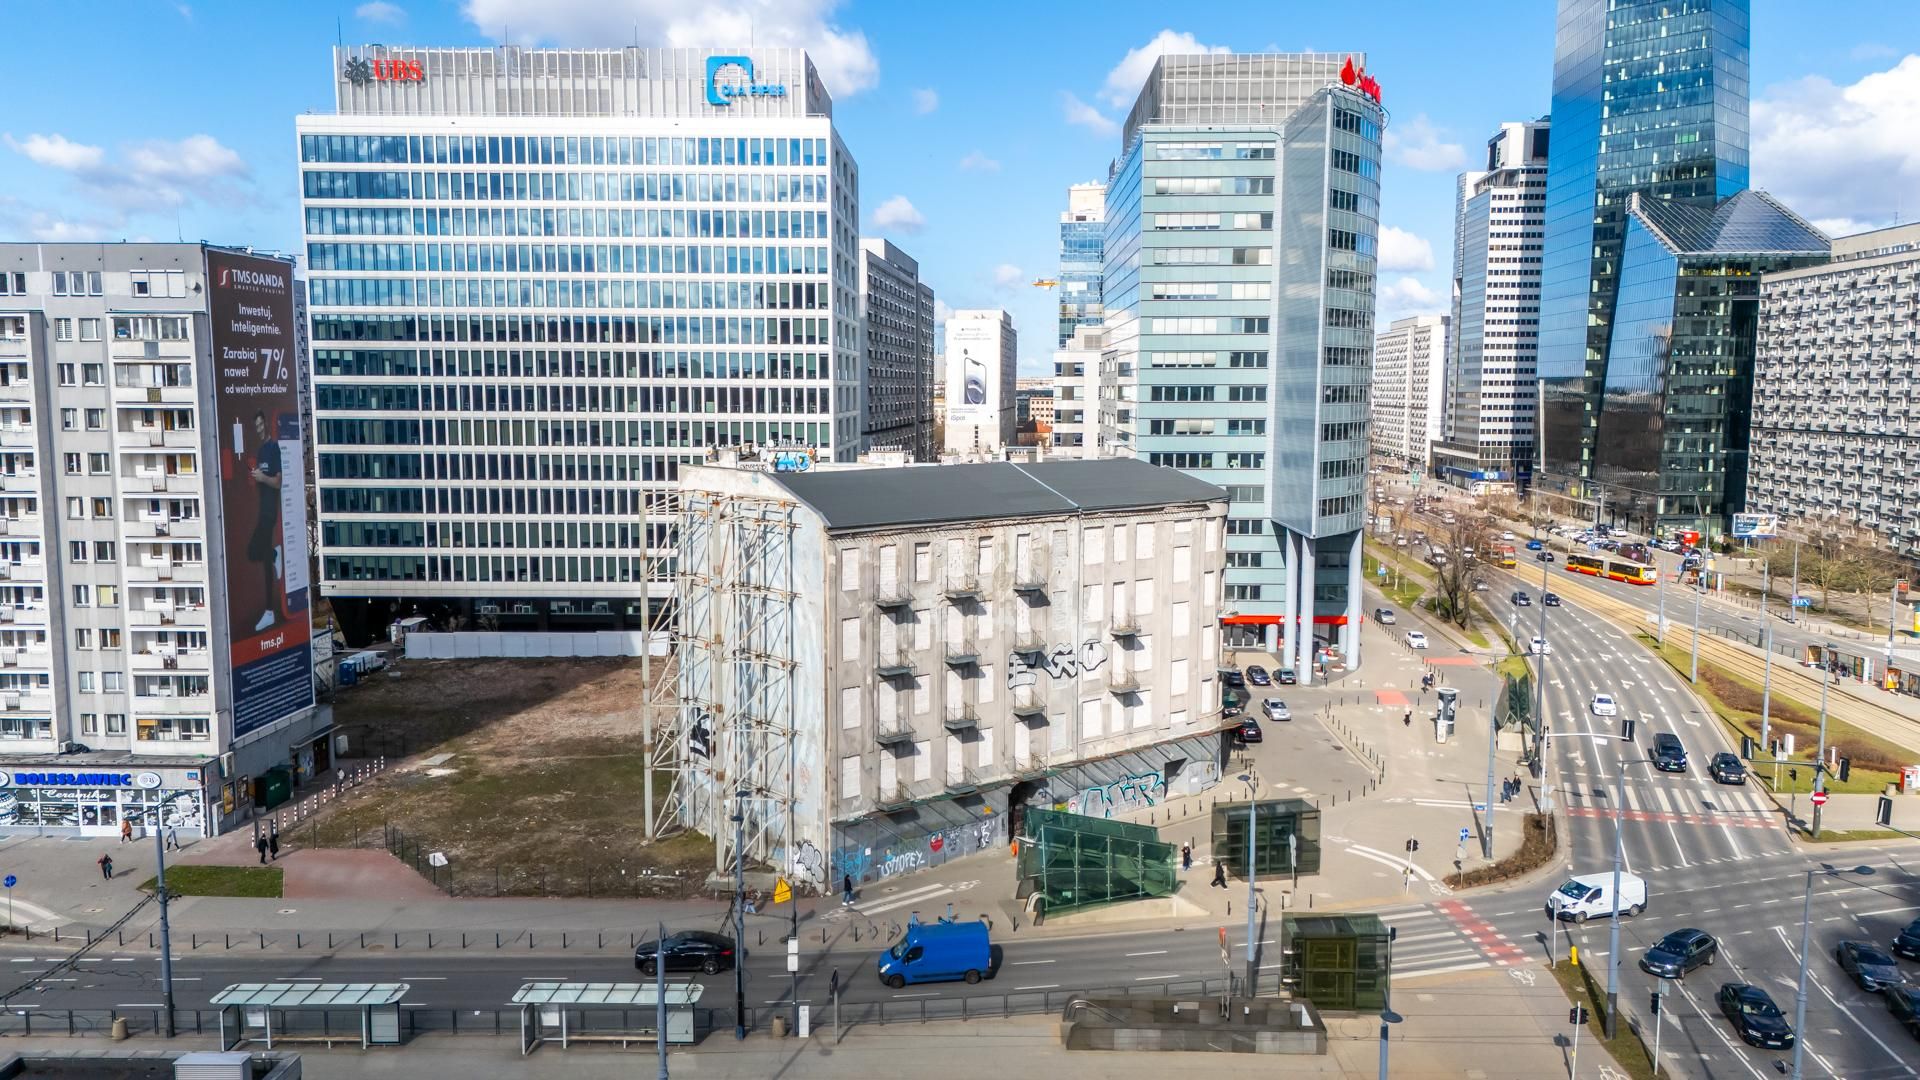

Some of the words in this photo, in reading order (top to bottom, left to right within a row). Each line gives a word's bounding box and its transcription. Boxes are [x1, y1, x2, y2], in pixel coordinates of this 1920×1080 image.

[372, 60, 423, 80] UBS
[231, 269, 251, 284] TMS
[251, 271, 285, 288] OANDA
[238, 303, 273, 320] Inwestuj.
[231, 319, 281, 336] Inteligentnie.
[223, 347, 257, 363] Zarabiaj
[261, 348, 288, 379] 7%
[224, 365, 249, 378] nawet
[225, 384, 234, 394] od
[234, 383, 261, 396] wolnych
[260, 632, 284, 651] tms.pl
[15, 773, 131, 785] BOLESŁAWIEC
[41, 788, 110, 799] Ceramika
